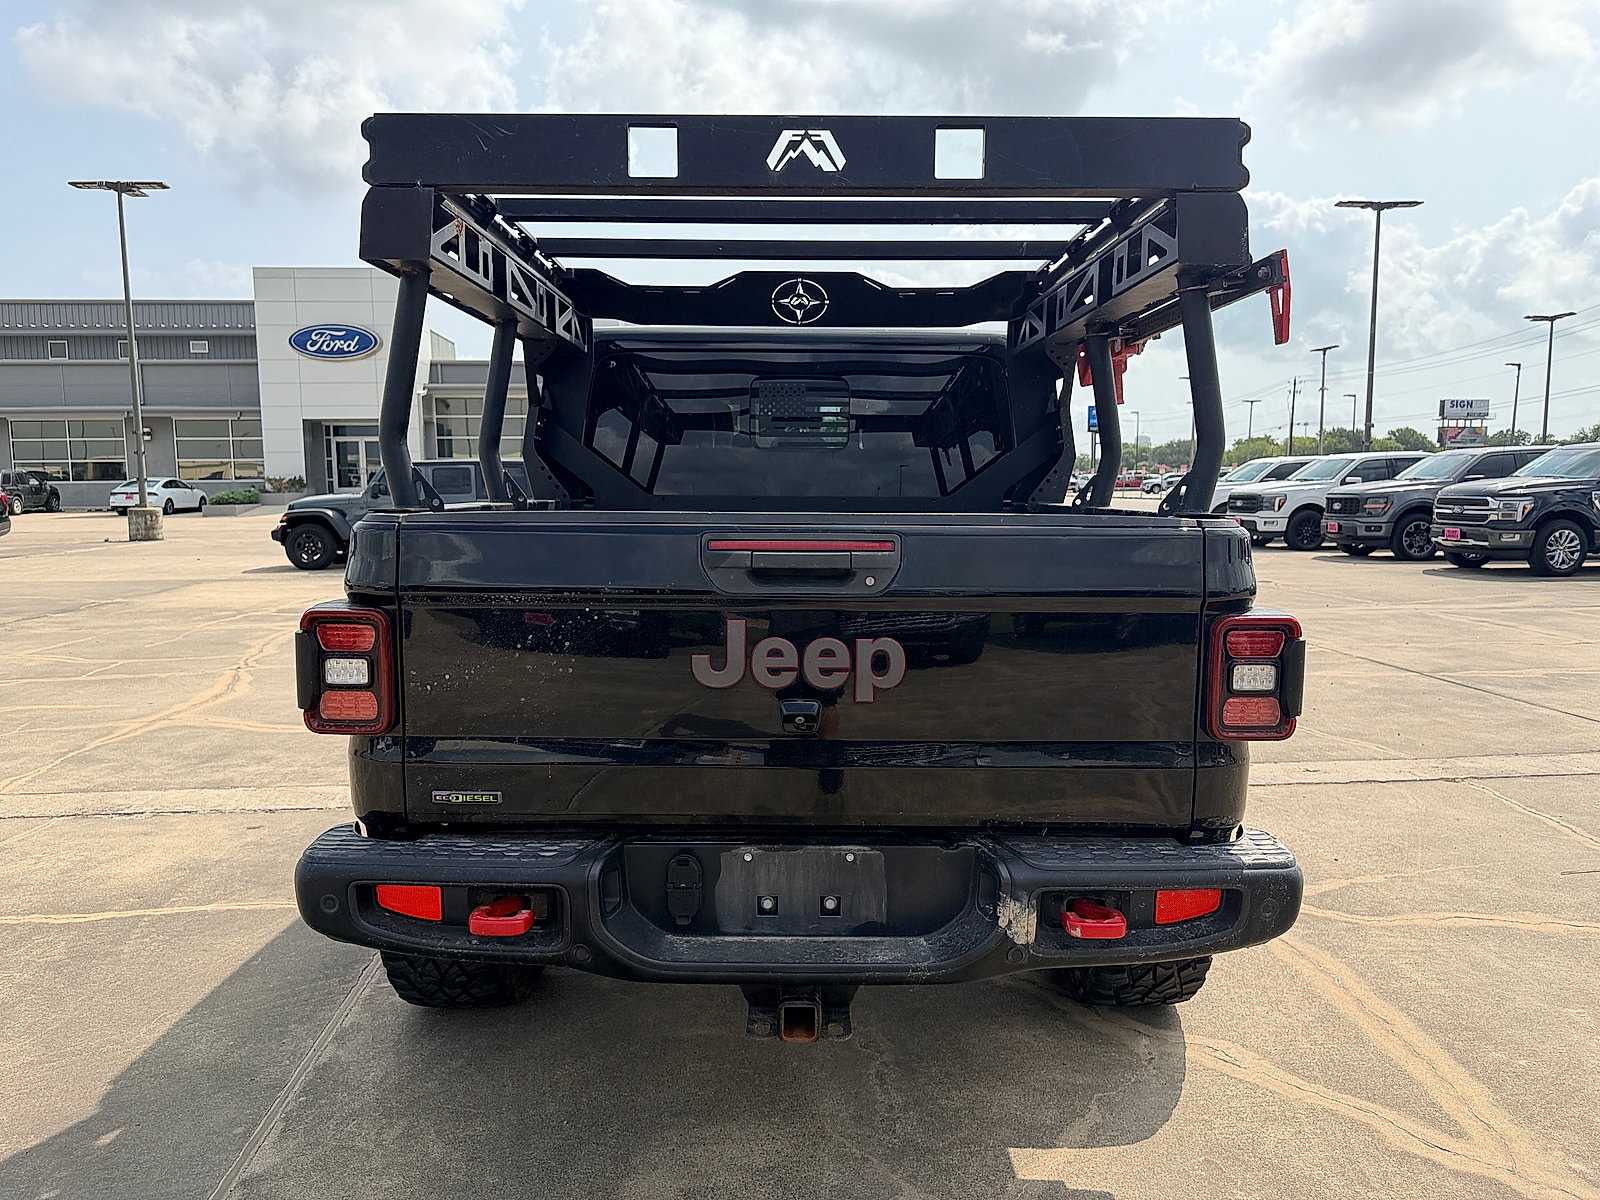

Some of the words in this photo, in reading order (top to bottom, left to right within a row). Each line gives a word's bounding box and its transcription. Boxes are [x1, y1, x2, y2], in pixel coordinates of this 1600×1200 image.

[306, 330, 360, 352] Ford
[1450, 400, 1474, 408] SIGN
[691, 619, 906, 703] Jeep
